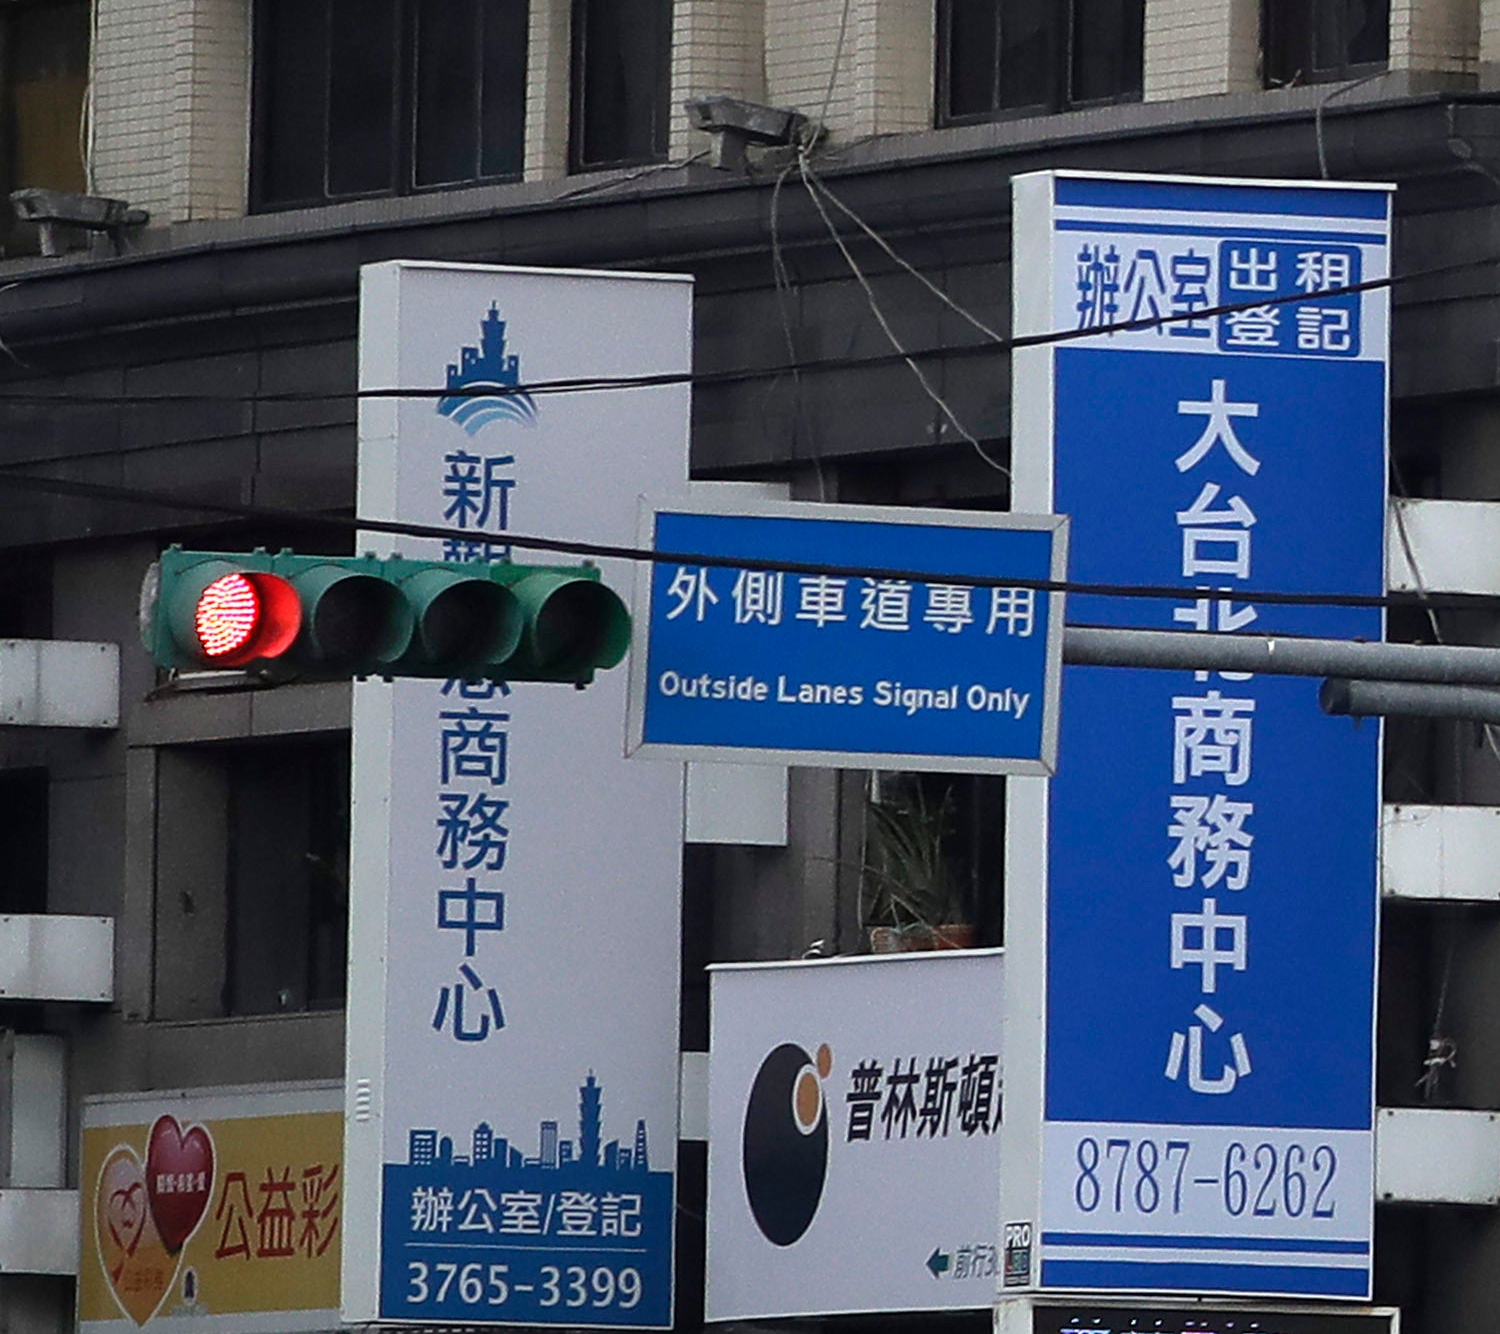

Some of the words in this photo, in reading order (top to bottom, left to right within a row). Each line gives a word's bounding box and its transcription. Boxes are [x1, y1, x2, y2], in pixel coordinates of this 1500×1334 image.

[1076, 244, 1211, 340] 辦公室
[1225, 306, 1350, 351] 登記
[666, 566, 1036, 637] 外側車道專用
[659, 670, 768, 702] Outside
[778, 676, 863, 705] Lanes
[873, 679, 958, 716] Signal
[967, 684, 1030, 719] Only
[433, 449, 517, 1042] 新商務中心
[1075, 1137, 1338, 1219] 8787-6262
[411, 1187, 643, 1239] 辦公室/登記
[406, 1262, 643, 1308] 3765-3399
